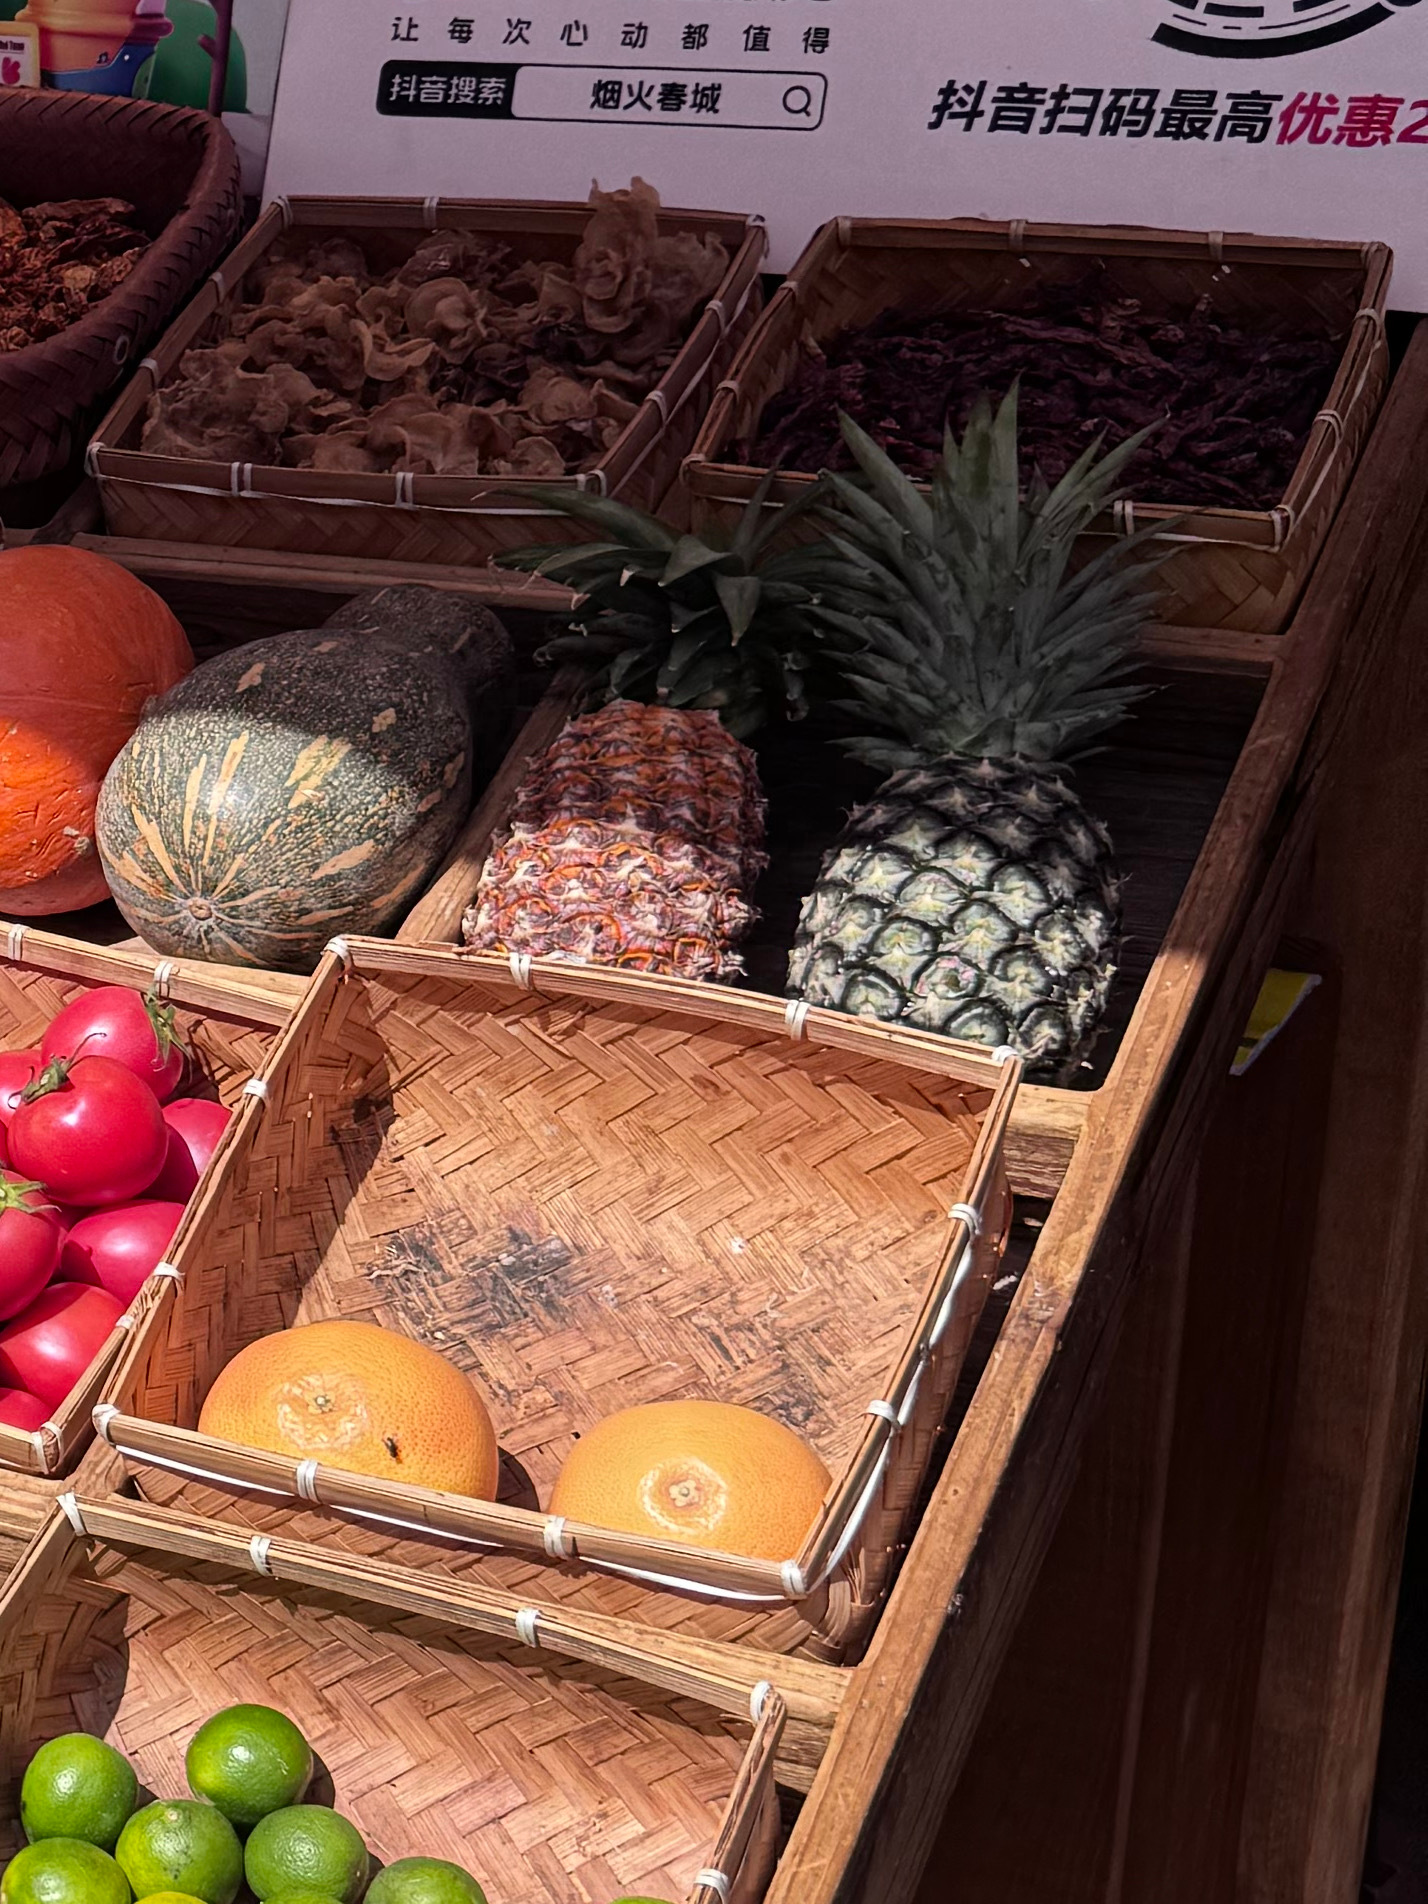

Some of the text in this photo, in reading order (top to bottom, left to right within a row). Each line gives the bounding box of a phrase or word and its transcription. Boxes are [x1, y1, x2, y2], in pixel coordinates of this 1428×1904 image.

[390, 16, 831, 55] 让每次心动都值得
[389, 73, 507, 107] 抖音搜索
[589, 79, 722, 114] 烟火春城
[927, 79, 1428, 149] 抖音扫码最高优惠2
